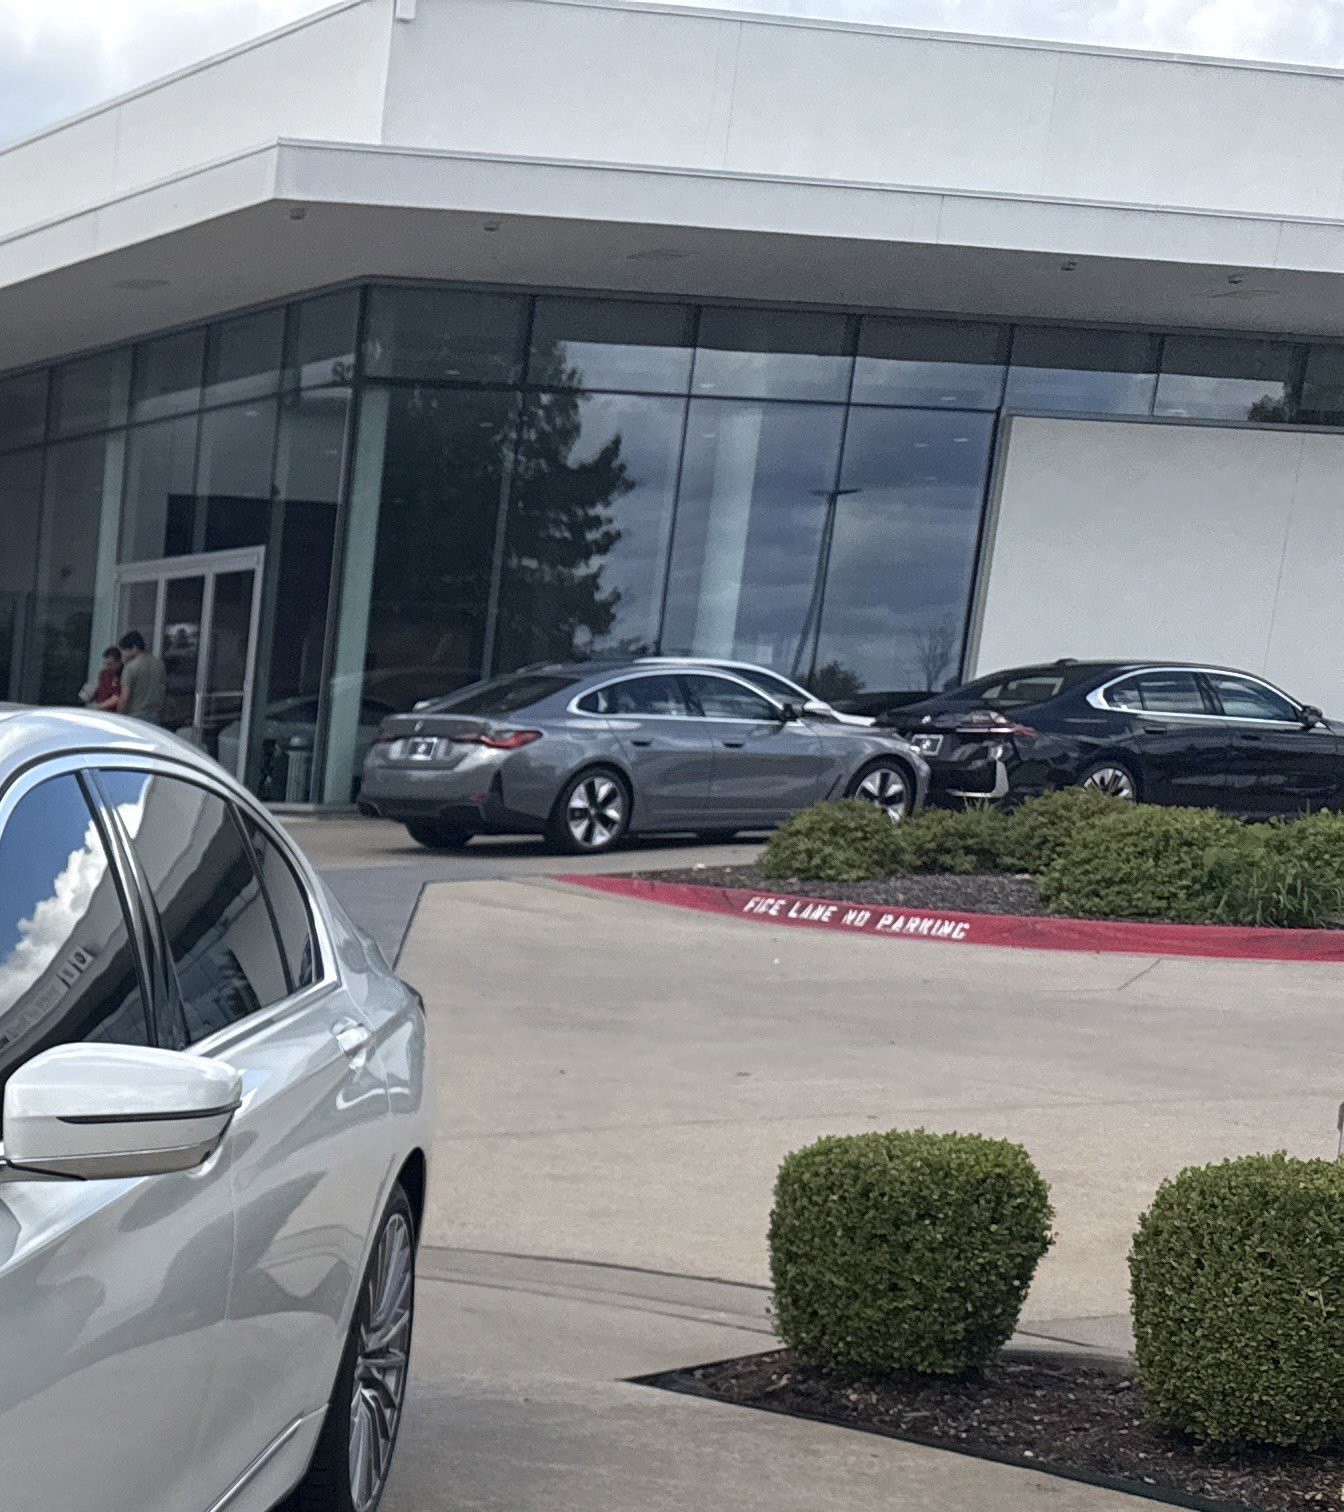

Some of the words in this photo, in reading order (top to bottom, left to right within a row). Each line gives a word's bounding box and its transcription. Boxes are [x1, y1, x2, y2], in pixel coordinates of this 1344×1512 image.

[788, 900, 839, 922] LANE
[841, 908, 872, 928] NO
[876, 913, 971, 939] PARKING
